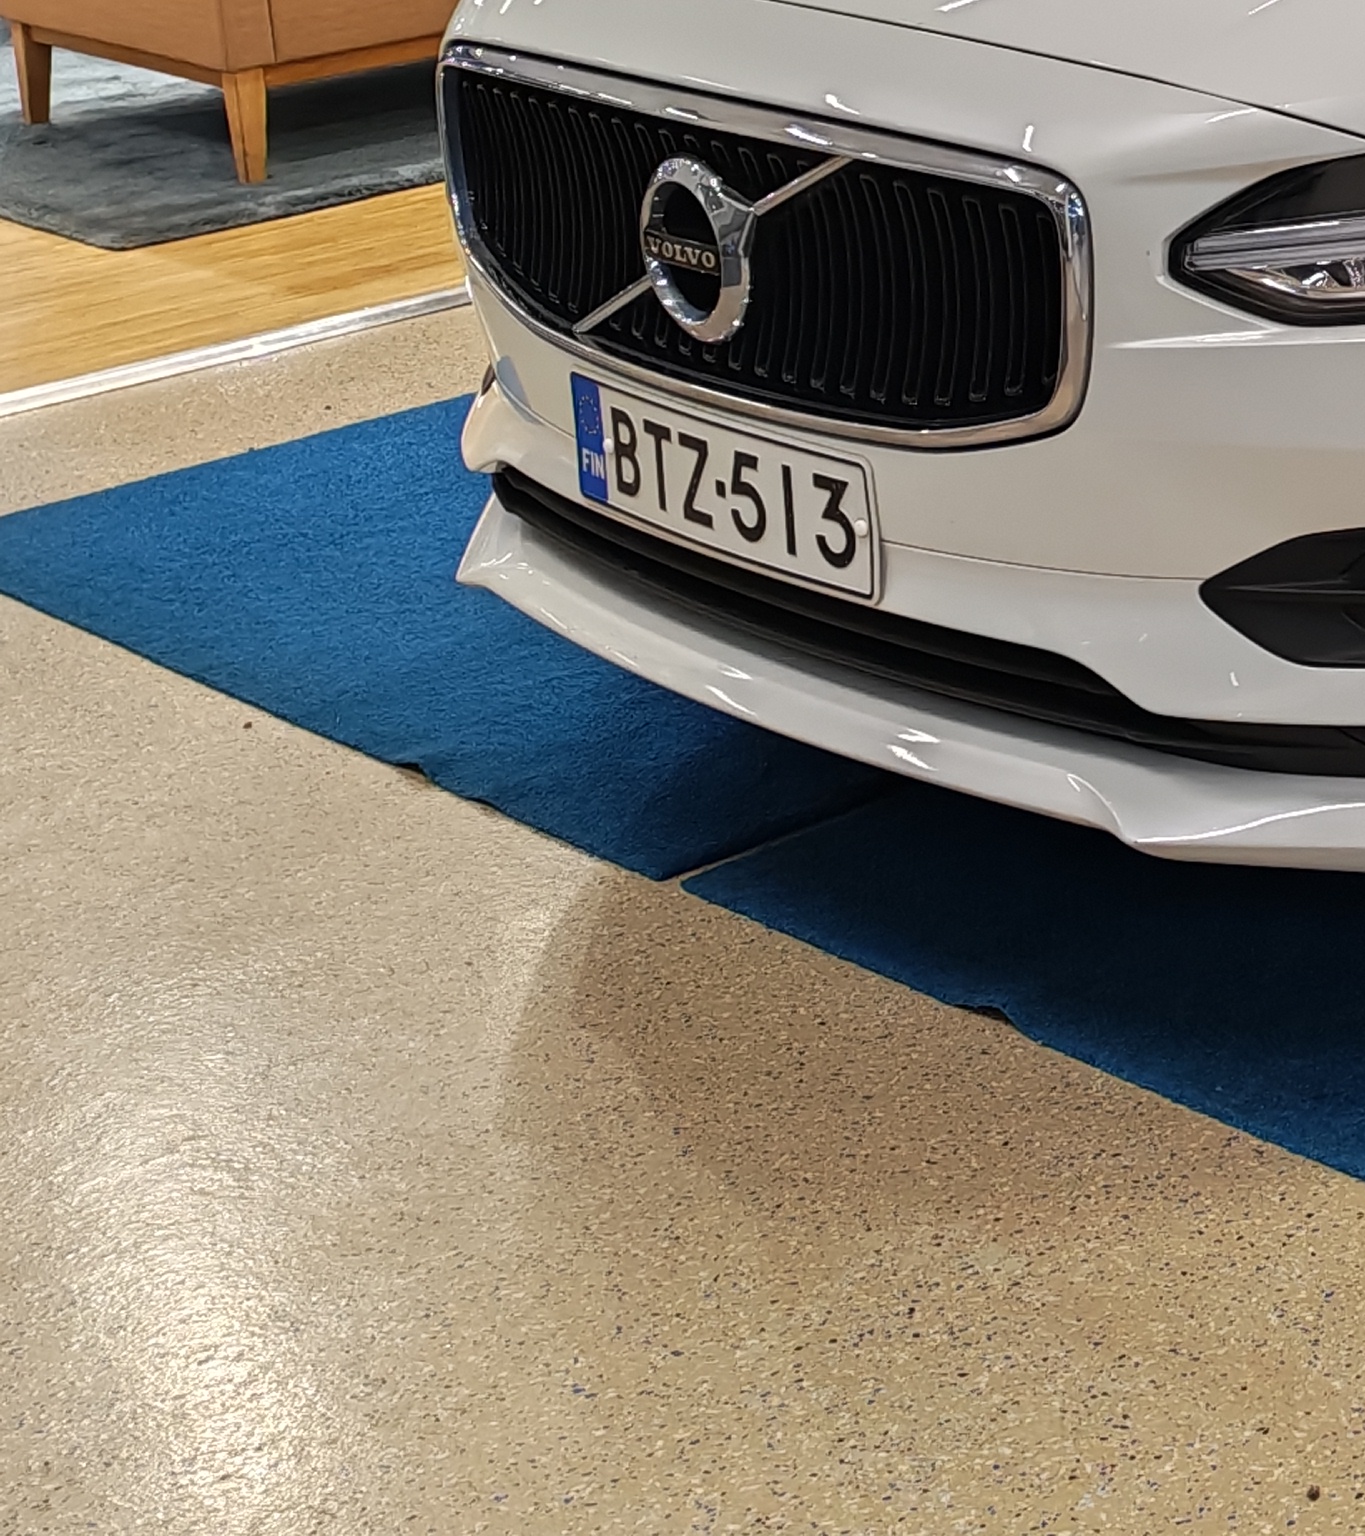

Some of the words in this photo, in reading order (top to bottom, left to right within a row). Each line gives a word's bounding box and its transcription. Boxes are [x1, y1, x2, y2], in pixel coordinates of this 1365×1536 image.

[646, 235, 716, 269] VOLVO
[582, 447, 605, 481] FIN
[611, 405, 857, 569] BTZ-513
